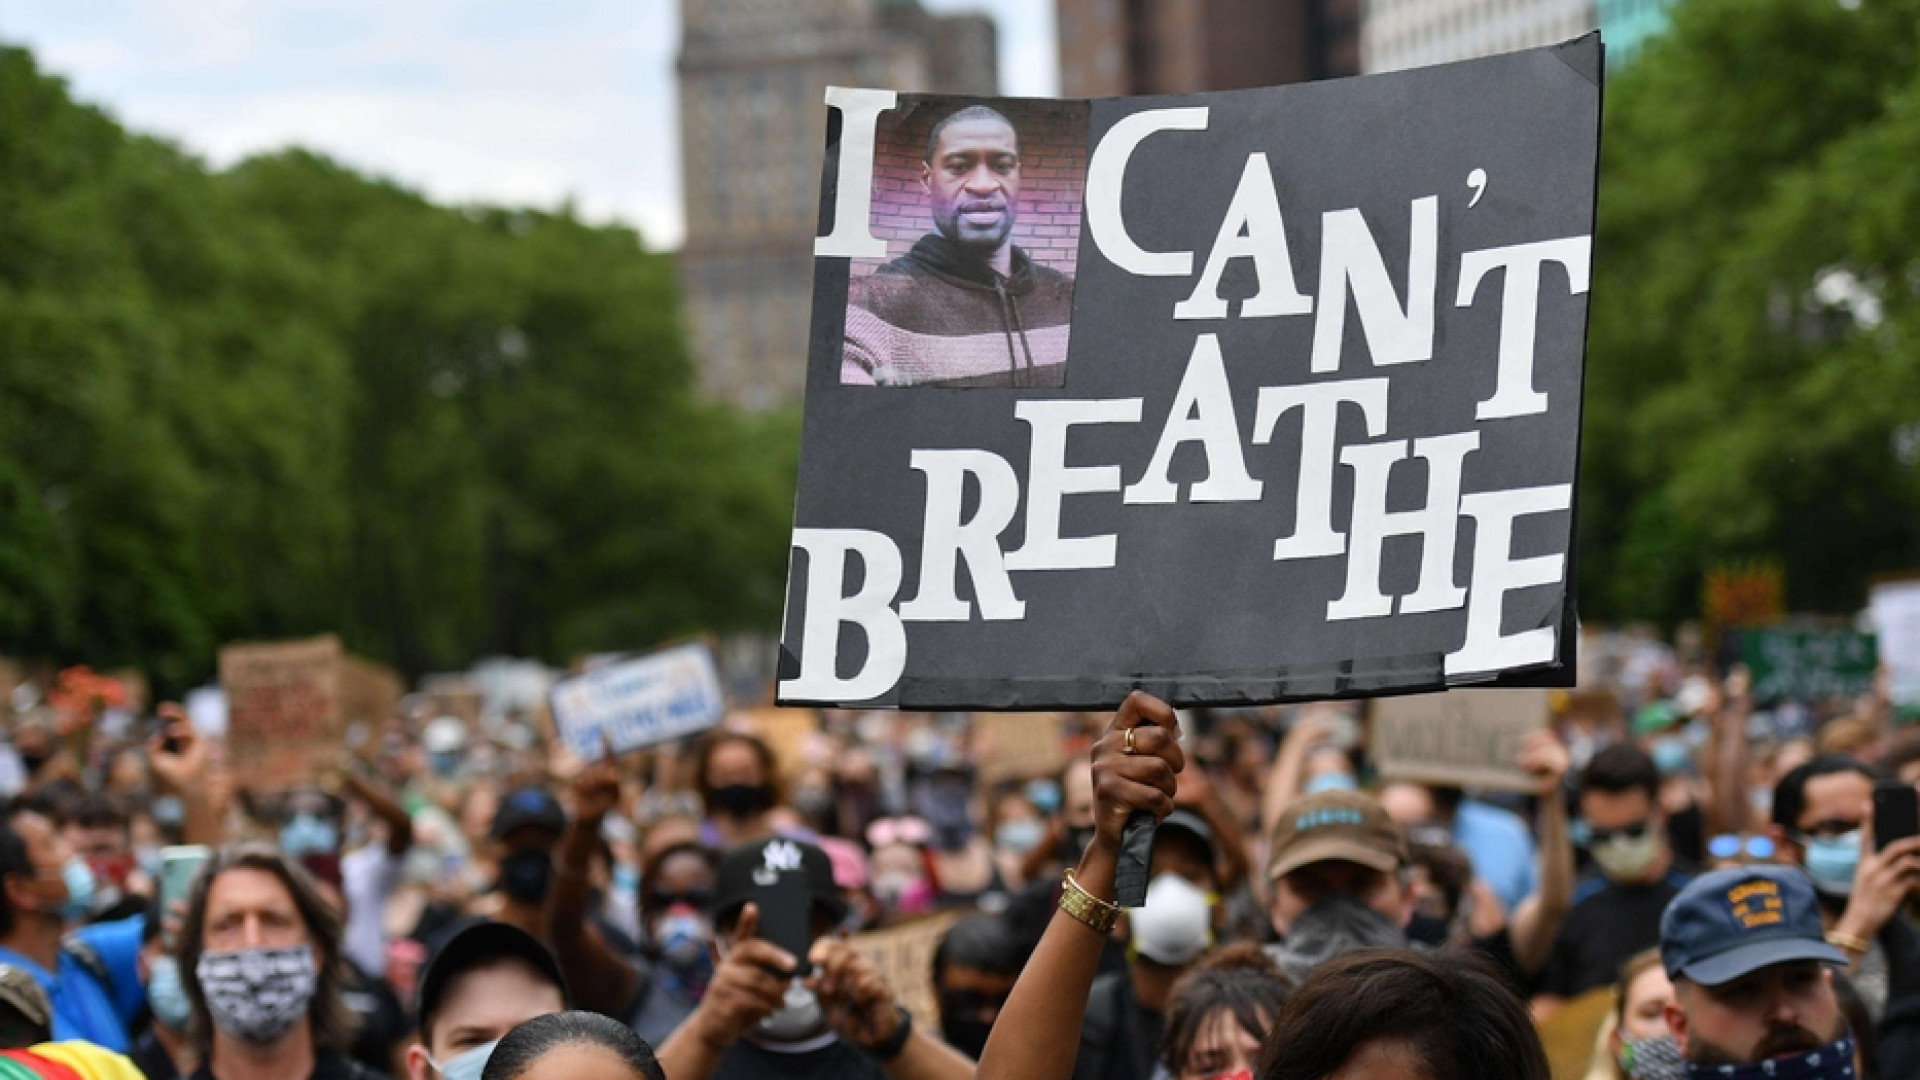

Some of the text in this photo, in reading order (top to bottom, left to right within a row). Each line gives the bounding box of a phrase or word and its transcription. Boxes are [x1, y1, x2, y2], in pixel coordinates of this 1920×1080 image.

[815, 87, 1591, 421] I CAN'T
[779, 333, 1571, 700] BREATHE
